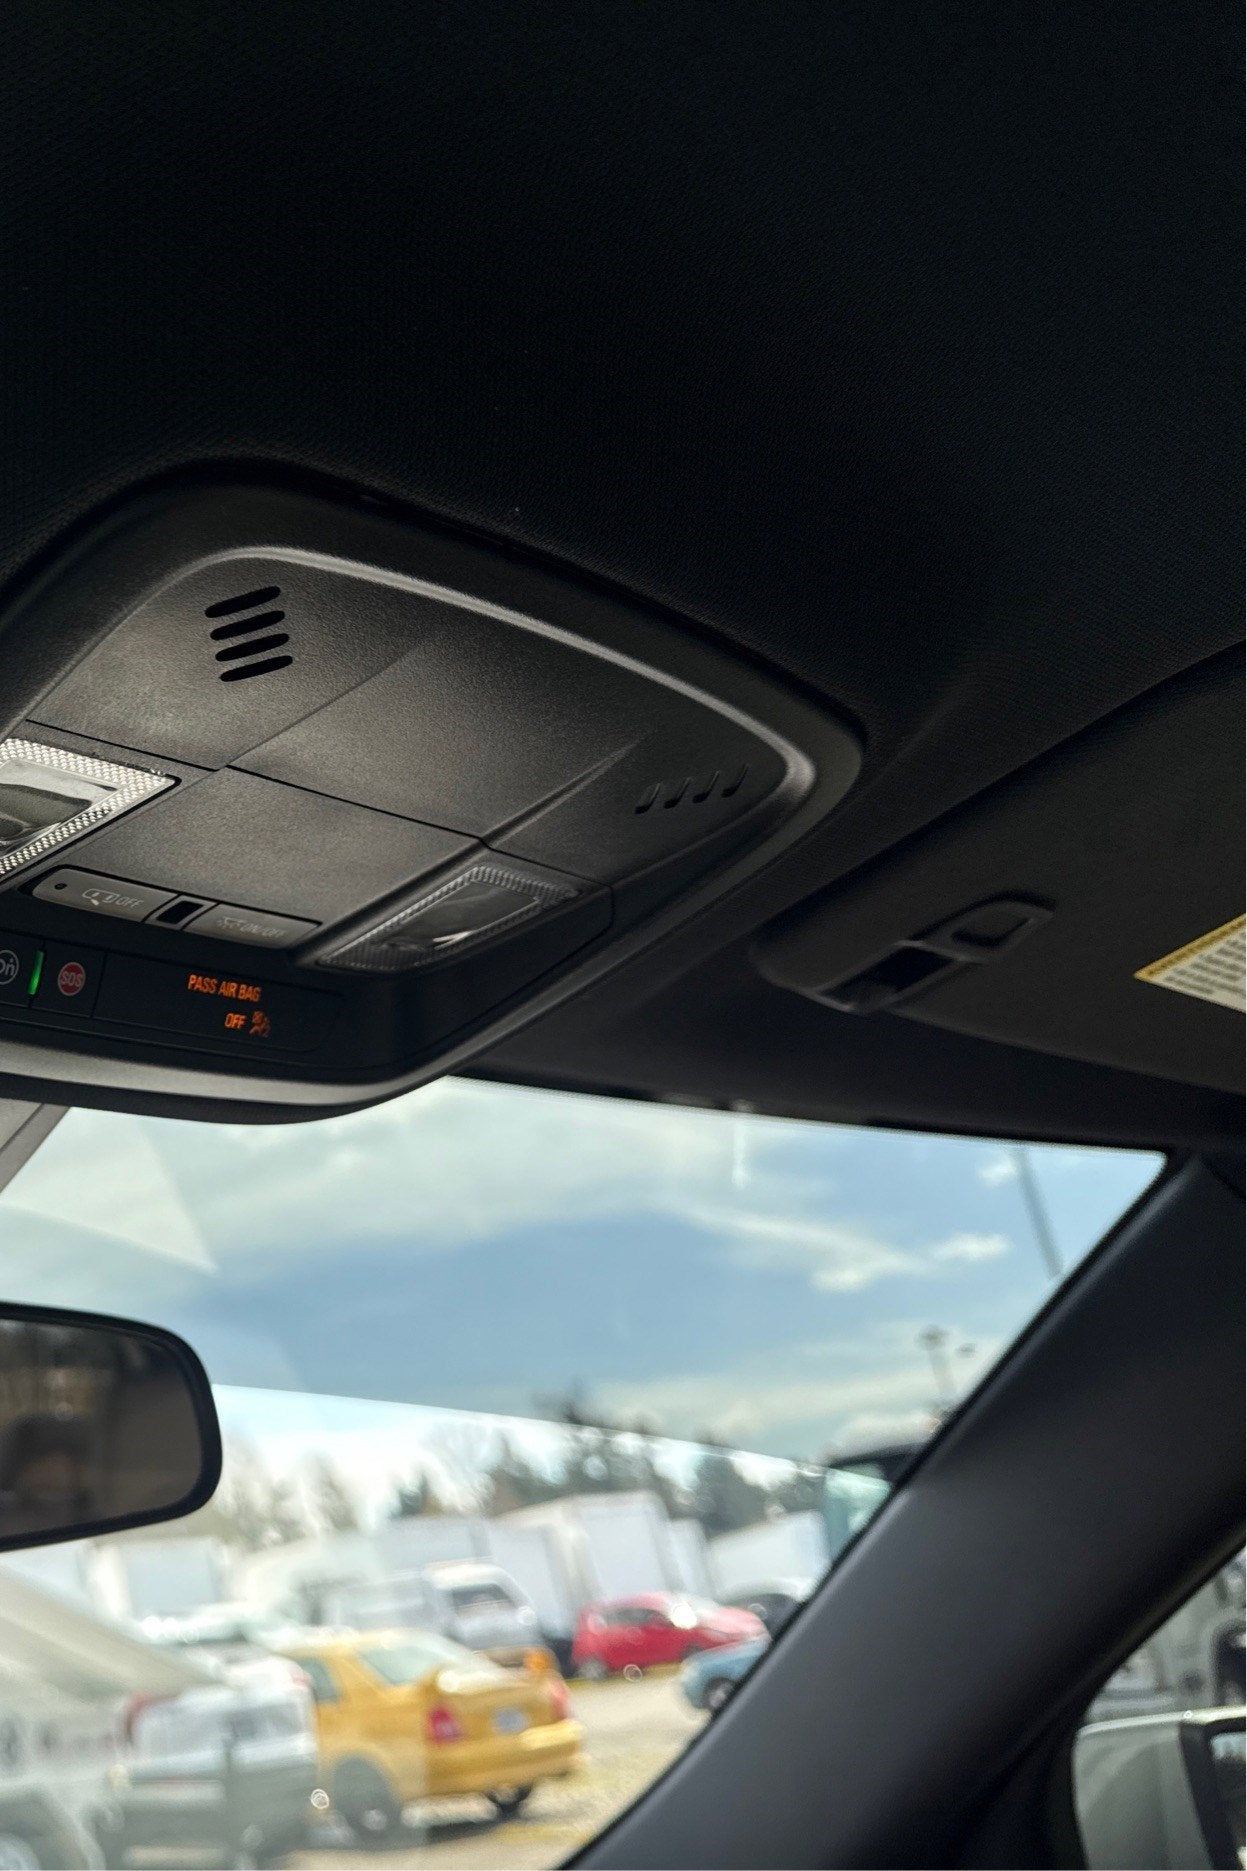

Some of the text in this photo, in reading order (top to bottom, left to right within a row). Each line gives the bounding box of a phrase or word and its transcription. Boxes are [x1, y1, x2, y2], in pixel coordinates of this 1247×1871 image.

[115, 896, 144, 908] OFF
[61, 970, 84, 988] SOS
[188, 974, 262, 1002] PASS AIR BAG
[224, 1013, 246, 1029] OFF
